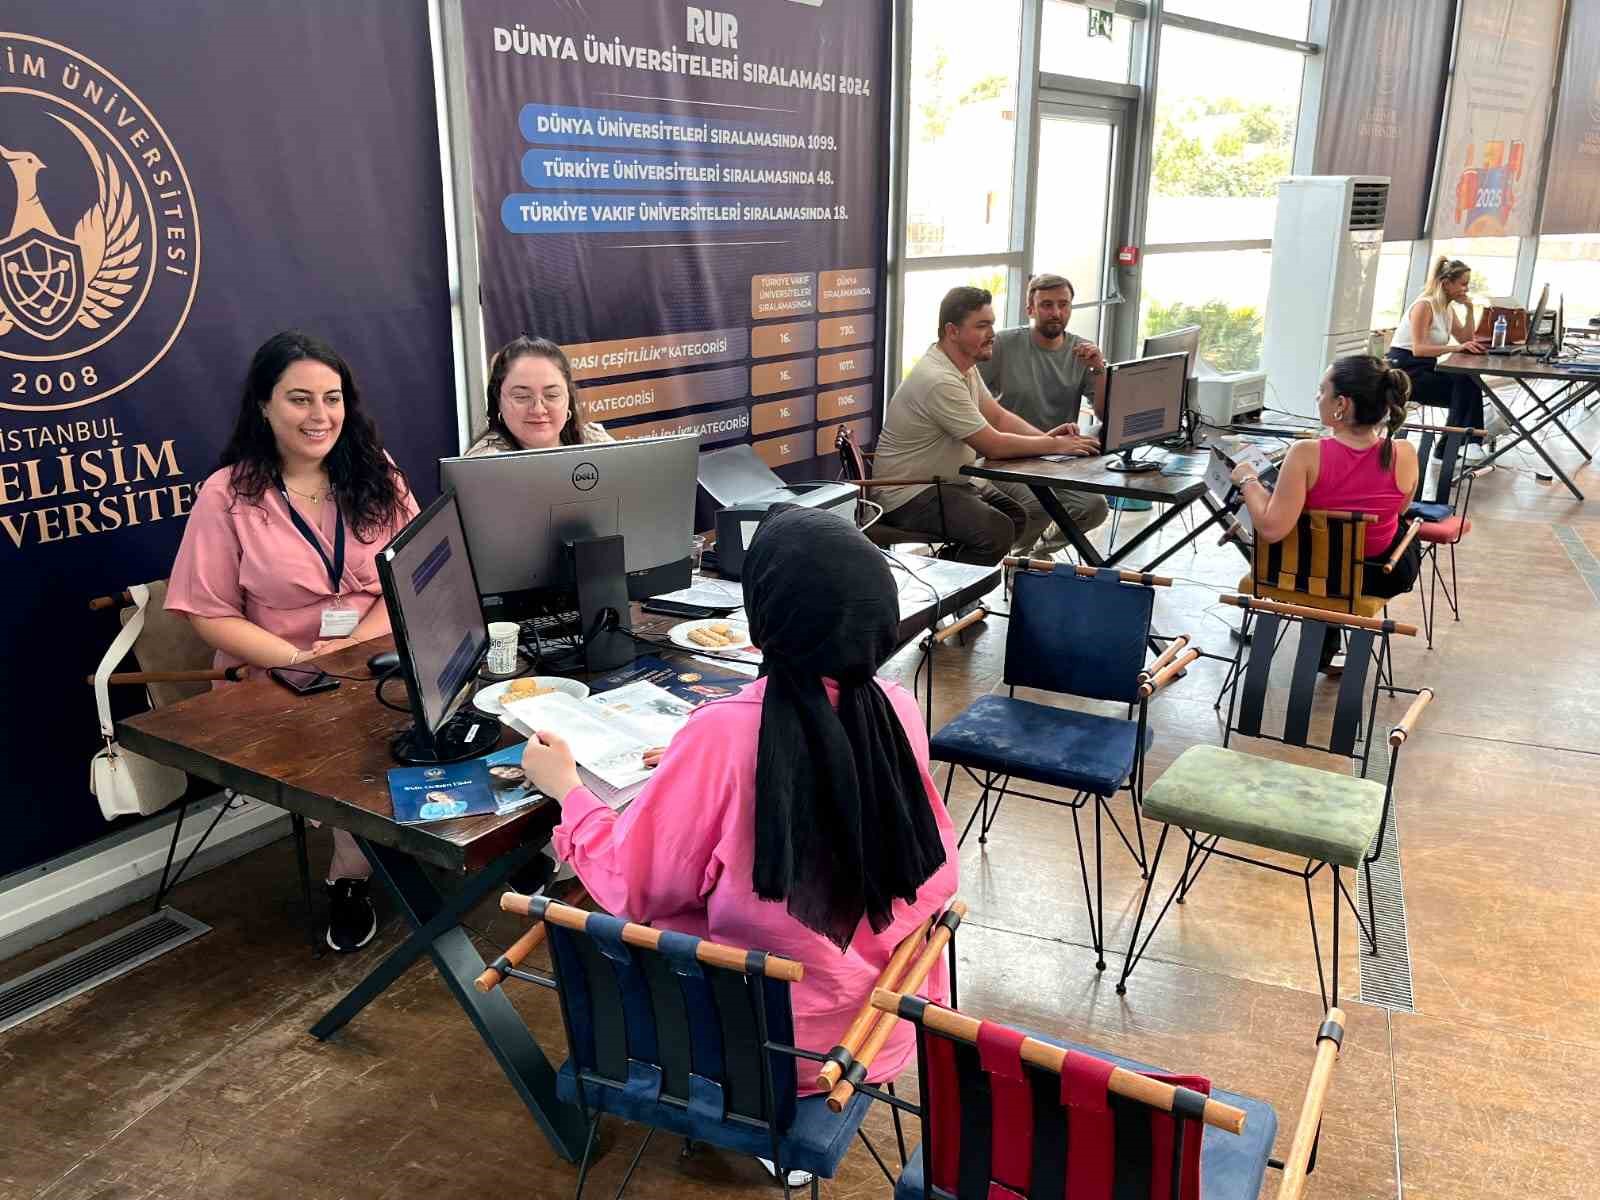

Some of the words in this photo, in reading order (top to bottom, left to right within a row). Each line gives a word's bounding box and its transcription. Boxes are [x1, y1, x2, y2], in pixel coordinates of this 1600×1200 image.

[686, 6, 738, 49] RUR
[493, 23, 578, 62] DÜNYA
[583, 36, 739, 82] ÜNİVERSİTELERİ
[742, 61, 836, 94] SIRALAMASI
[838, 75, 871, 97] 2024
[537, 112, 594, 136] DÜNYA
[597, 117, 707, 144] ÜNİVERSİTELERİ
[710, 128, 805, 150] SIRALAMASINDA
[807, 134, 837, 151] 1099.
[0, 46, 46, 79] İM
[62, 63, 189, 276] ÜNİVERSİTESİ
[543, 157, 609, 180] TÜRKİYE
[613, 160, 720, 182] ÜNİVERSİTELERİ
[722, 168, 815, 186] SIRALAMASINDA
[816, 171, 834, 186] 48.
[519, 200, 588, 222] TÜRKİYE
[591, 205, 636, 222] VAKIF
[639, 201, 741, 222] ÜNİVERSİTELERİ
[743, 206, 832, 221] SIRALAMASINDA
[668, 337, 728, 359] KATEGORİSİ
[11, 366, 99, 395] 2008
[588, 388, 656, 413] KATEGORİSİ
[0, 417, 123, 453] İSTANBUL
[575, 472, 598, 482] DELL
